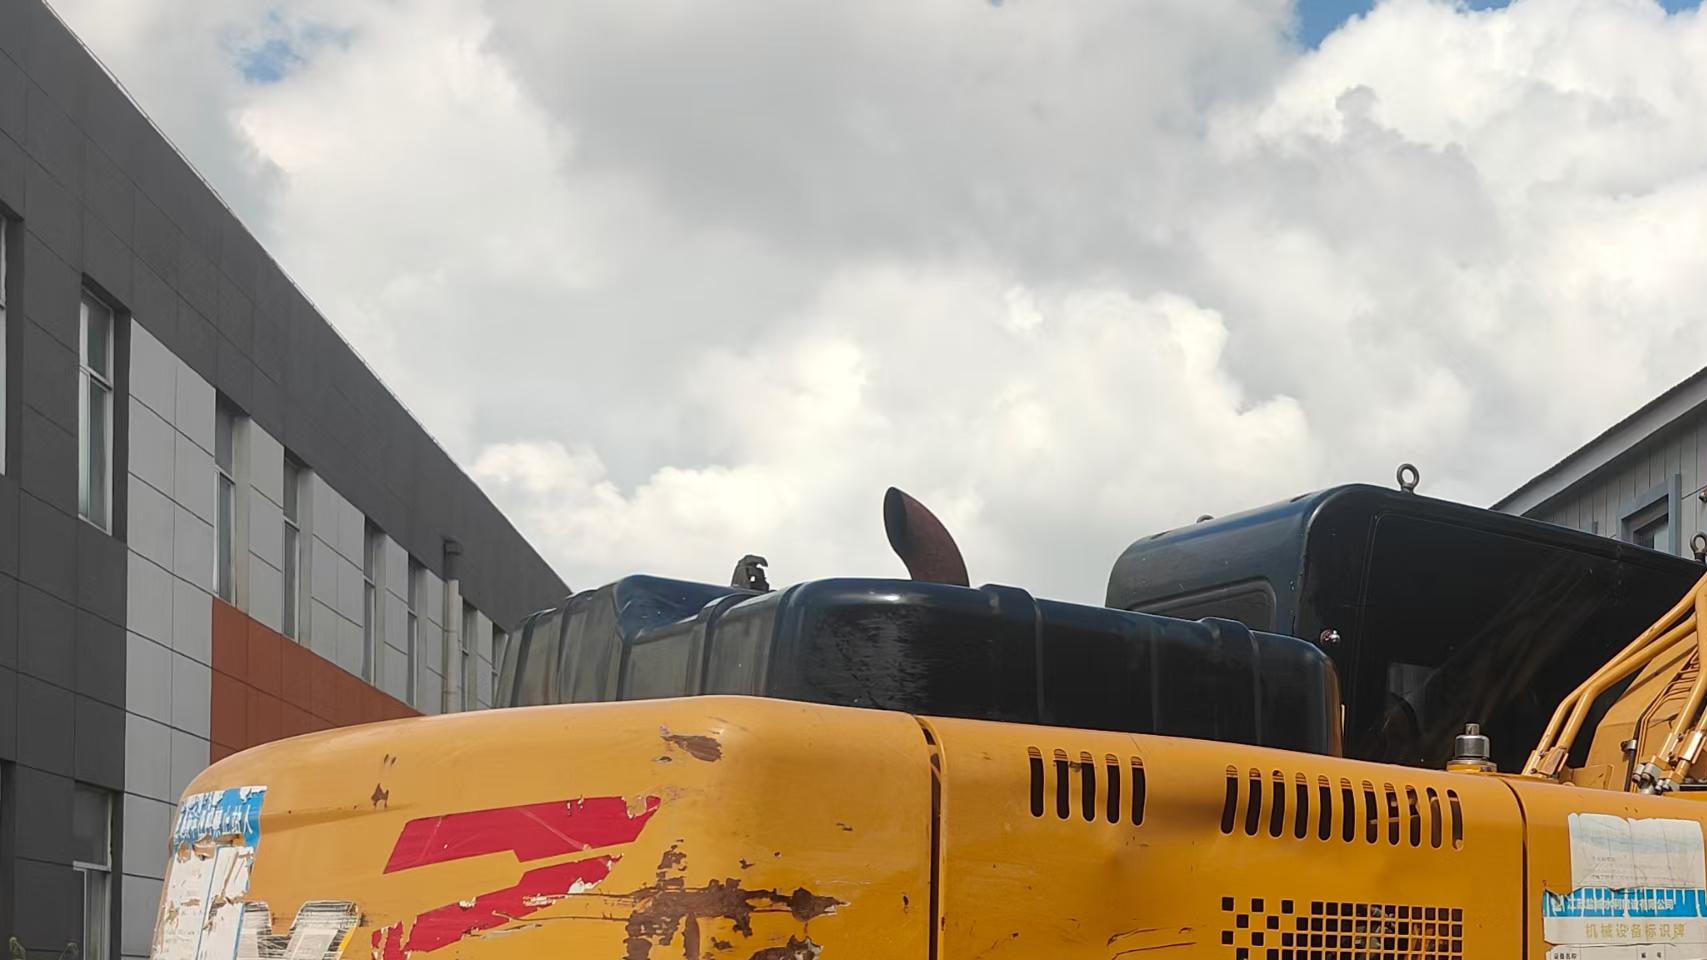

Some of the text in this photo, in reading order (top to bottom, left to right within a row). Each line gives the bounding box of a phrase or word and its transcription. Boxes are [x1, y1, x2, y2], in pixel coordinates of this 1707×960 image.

[1585, 922, 1687, 940] 机械设备标识牌
